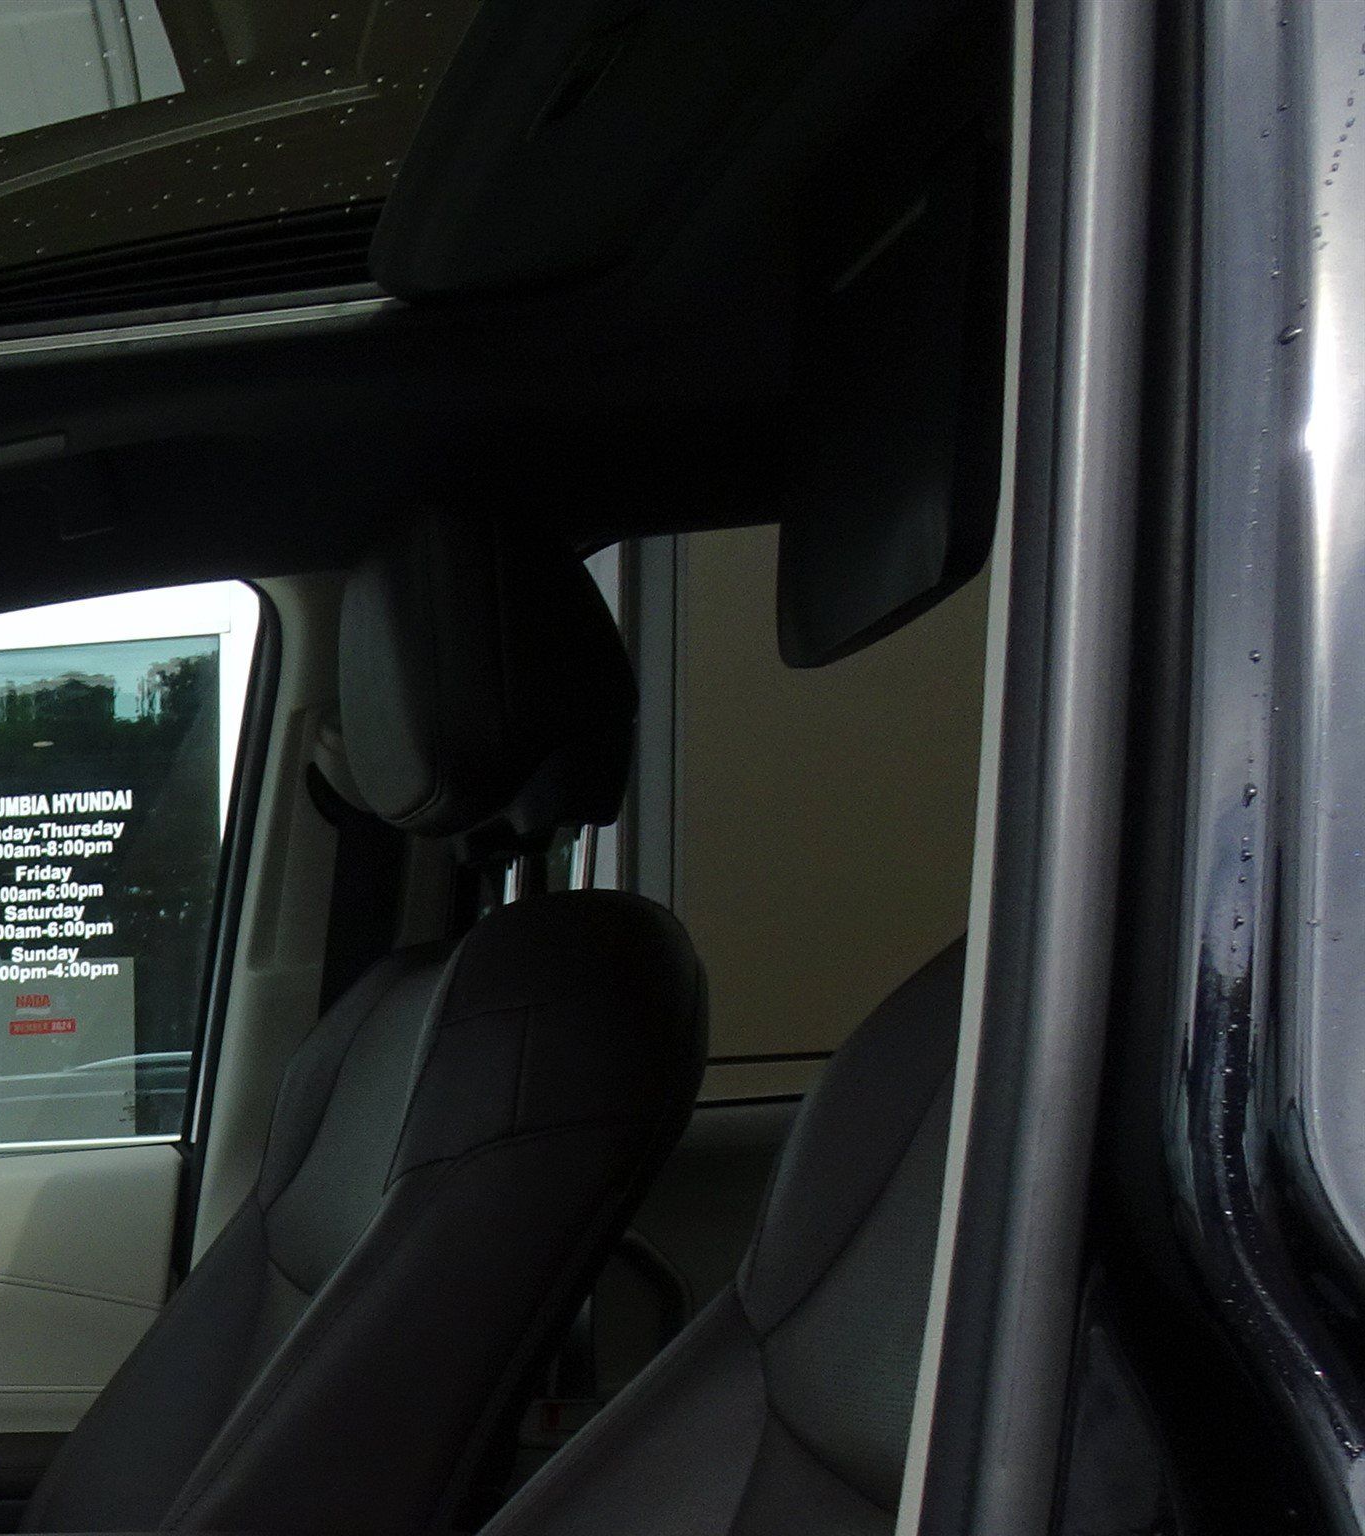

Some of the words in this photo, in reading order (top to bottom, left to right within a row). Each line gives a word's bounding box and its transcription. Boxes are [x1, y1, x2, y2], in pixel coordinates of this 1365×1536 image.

[52, 790, 132, 814] HYUNDAI
[15, 865, 72, 882] Friday
[4, 903, 85, 923] Saturday
[11, 945, 79, 963] Sunday
